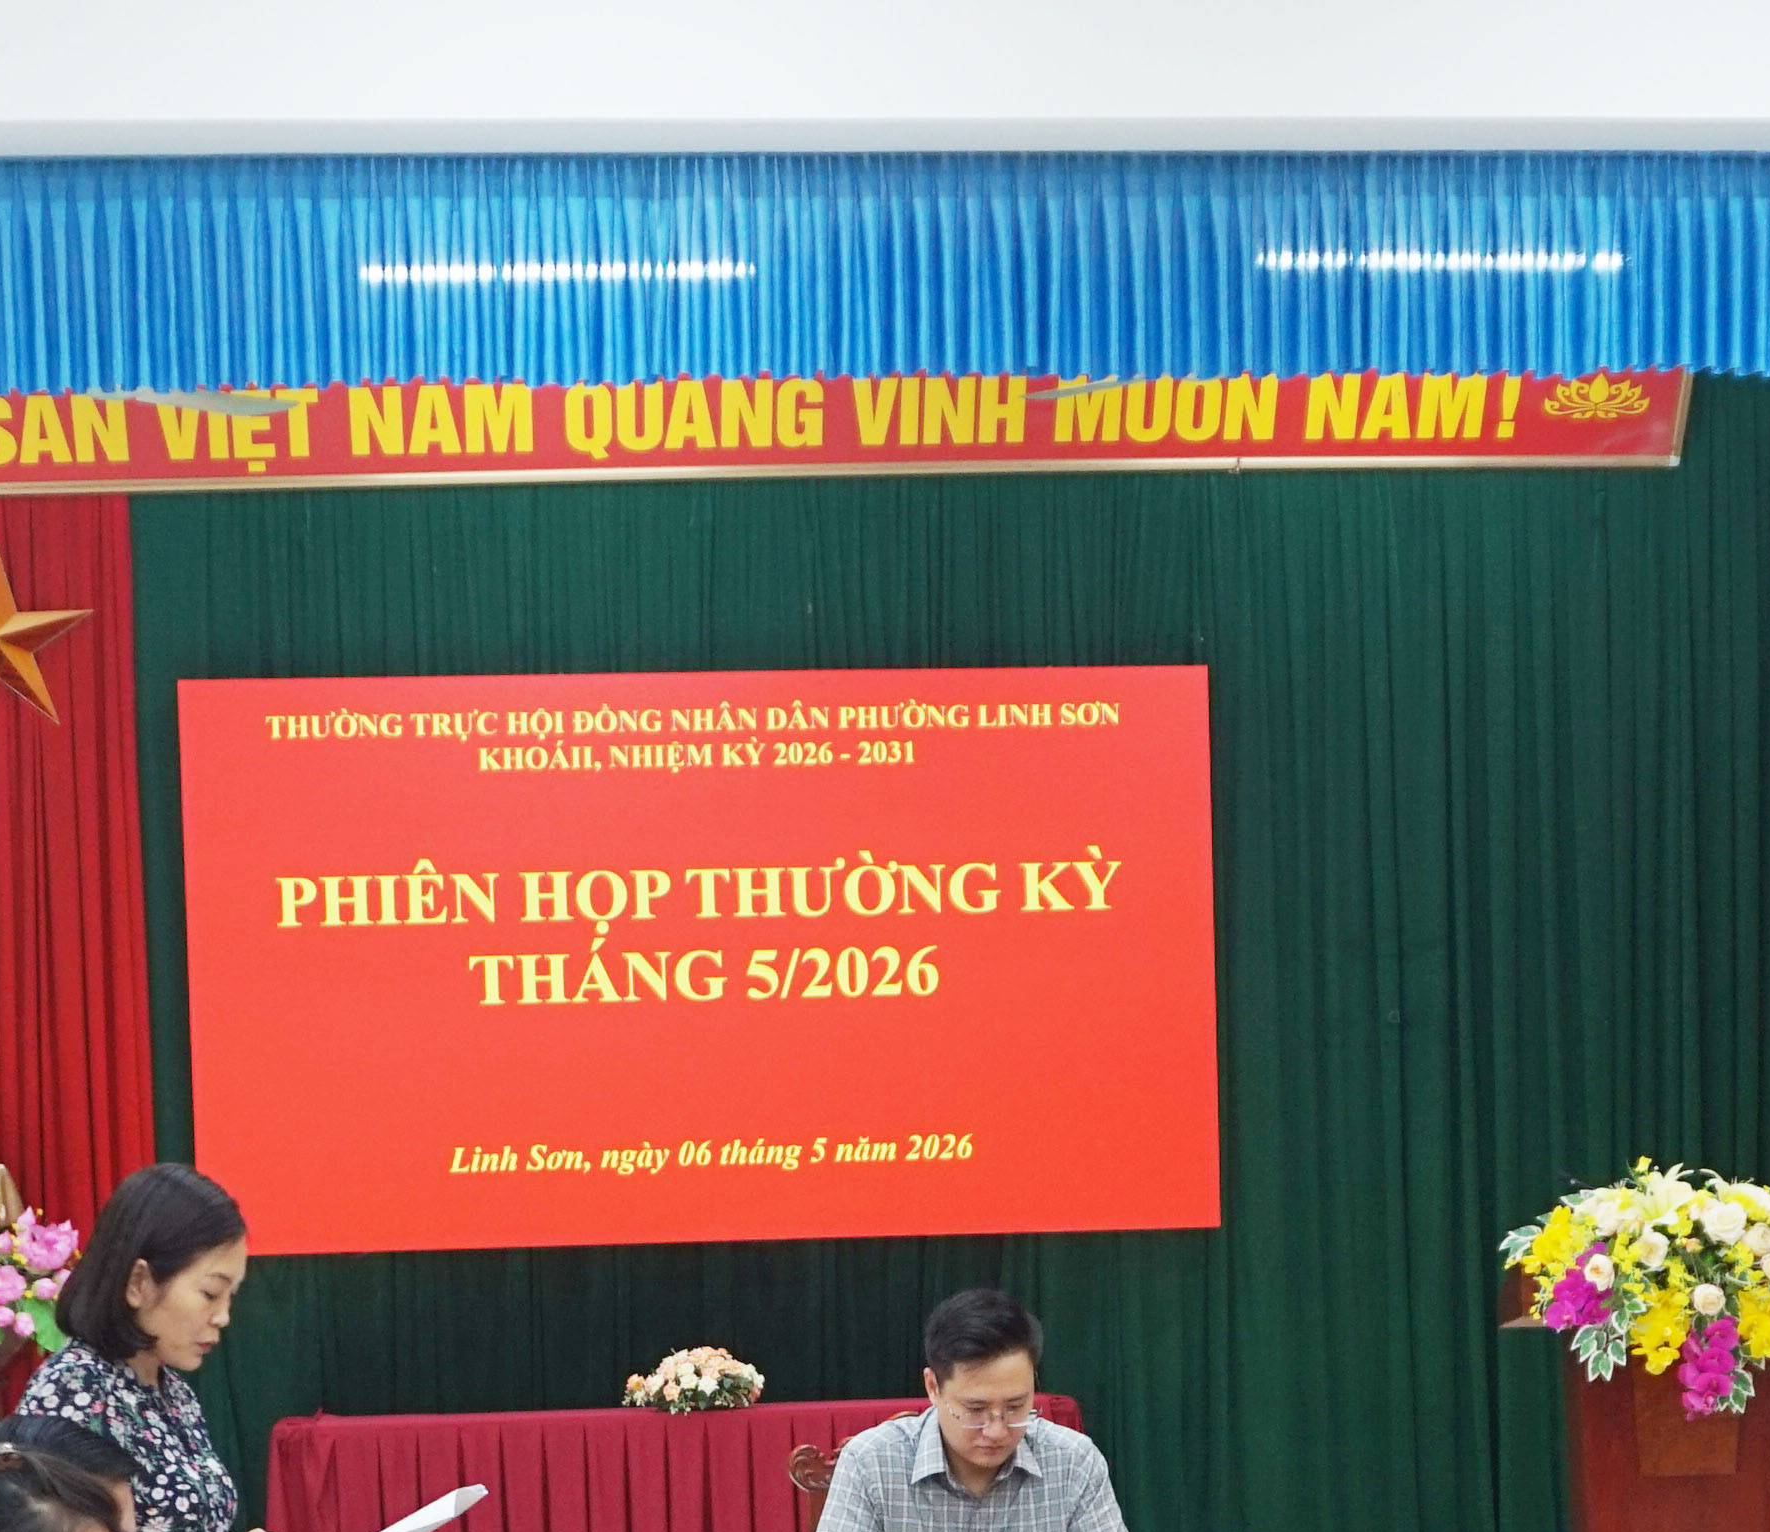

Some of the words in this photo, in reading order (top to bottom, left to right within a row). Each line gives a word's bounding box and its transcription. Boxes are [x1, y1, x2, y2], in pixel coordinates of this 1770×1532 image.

[349, 384, 534, 455] NAM
[564, 378, 824, 459] QUANG
[852, 375, 1028, 446] VINH
[266, 708, 403, 739] THƯỜNG
[411, 708, 498, 742] TRỰC
[507, 707, 564, 740] HỘI
[573, 703, 662, 734] ĐỒNG
[671, 701, 757, 731] NHÂN
[766, 700, 829, 731] DÂN
[838, 699, 970, 730] PHƯỜNG
[979, 704, 1052, 727] LINH
[1061, 700, 1121, 727] SƠN
[609, 741, 713, 773] NHIỆM
[721, 736, 766, 767] KỲ
[773, 741, 833, 766] 2026
[858, 740, 915, 765] 2031
[275, 858, 499, 928] PHIÊN
[519, 869, 671, 935] HỌP
[685, 849, 1002, 919] THƯỜNG
[1019, 844, 1122, 913] KỲ
[468, 937, 727, 1005] THÁNG
[745, 945, 940, 1000] 5/2026
[449, 1145, 518, 1174] Linh
[526, 1143, 591, 1174] Sơn,
[600, 1141, 669, 1176] ngày
[678, 1140, 712, 1168] 06
[719, 1138, 802, 1170] tháng
[809, 1137, 827, 1164] 5
[834, 1136, 897, 1162] năm
[904, 1133, 974, 1161] 2026
